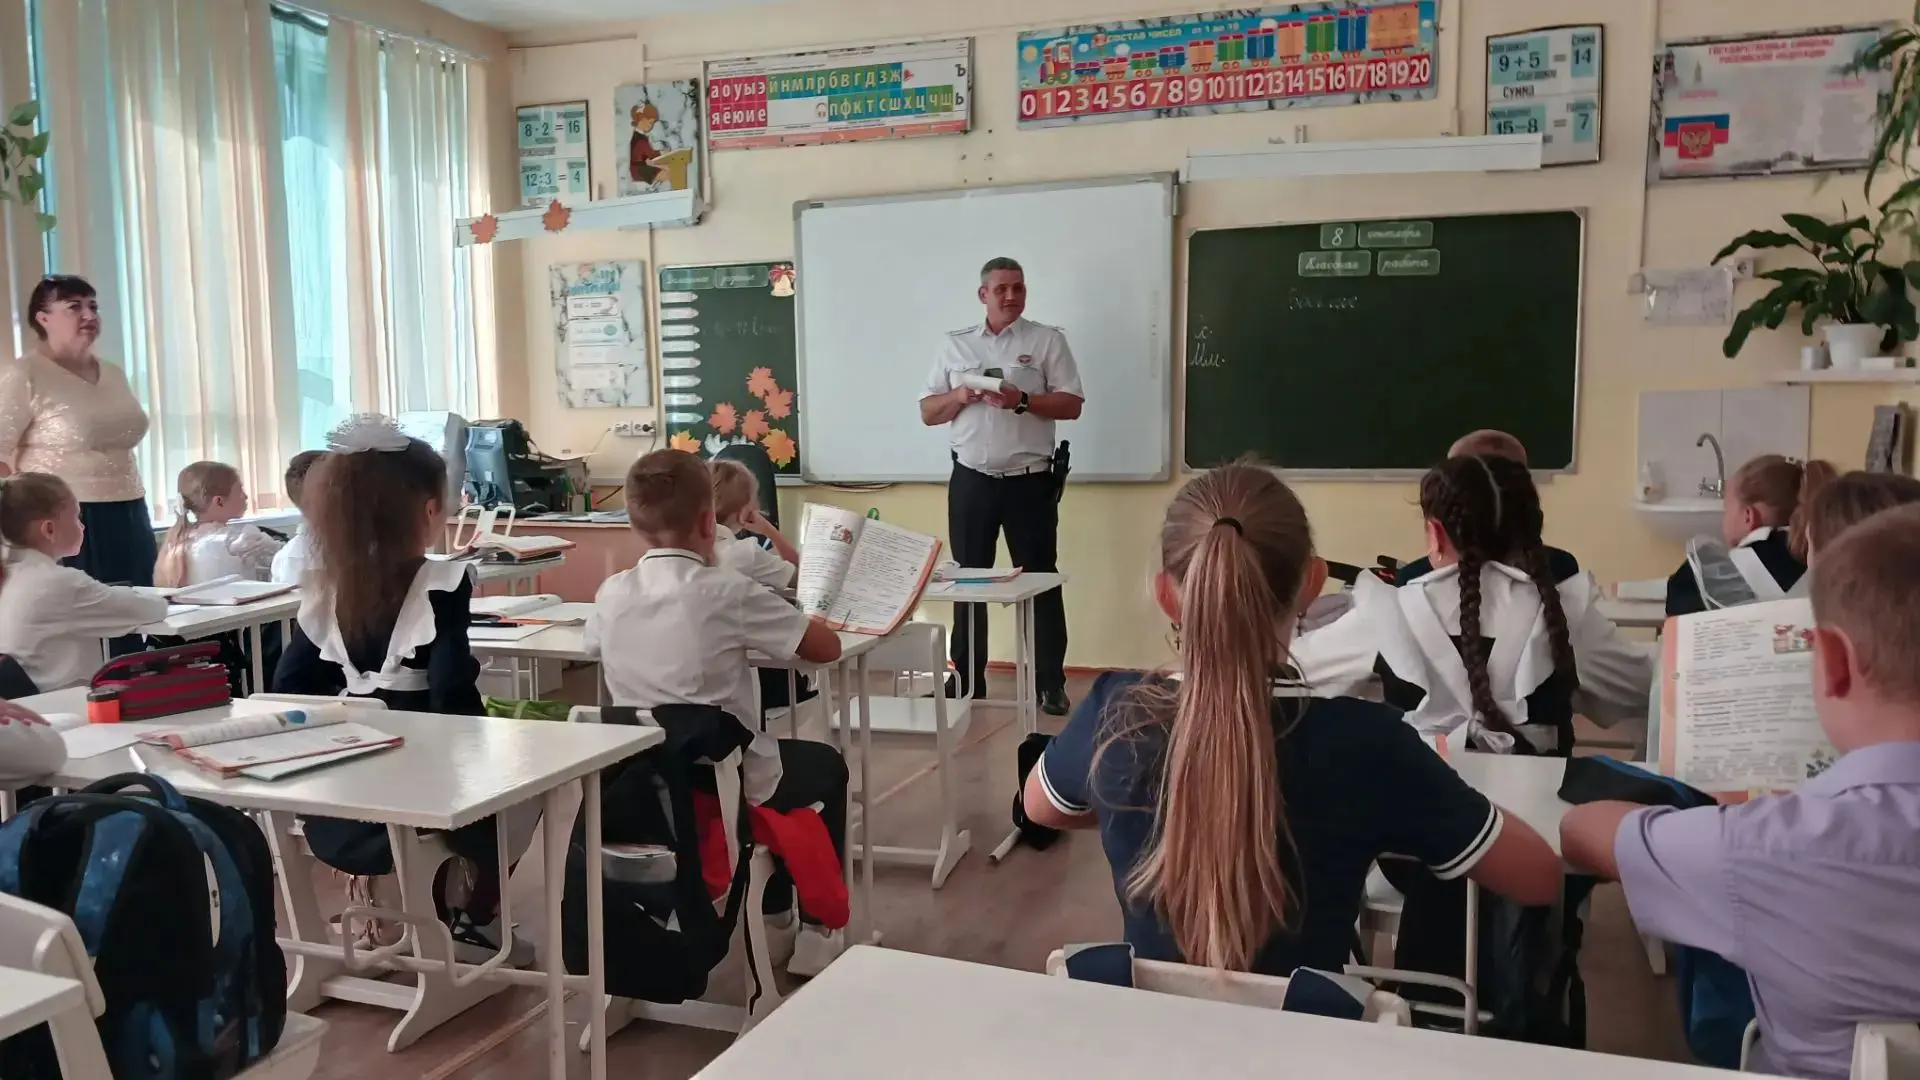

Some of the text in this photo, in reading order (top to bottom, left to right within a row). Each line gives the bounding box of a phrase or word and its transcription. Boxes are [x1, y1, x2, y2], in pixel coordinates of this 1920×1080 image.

[1499, 54, 1509, 72] 9
[1529, 51, 1540, 68] 5
[1575, 48, 1591, 64] 14
[568, 120, 580, 133] 16
[1578, 113, 1589, 130] 7
[1332, 227, 1343, 246] 8
